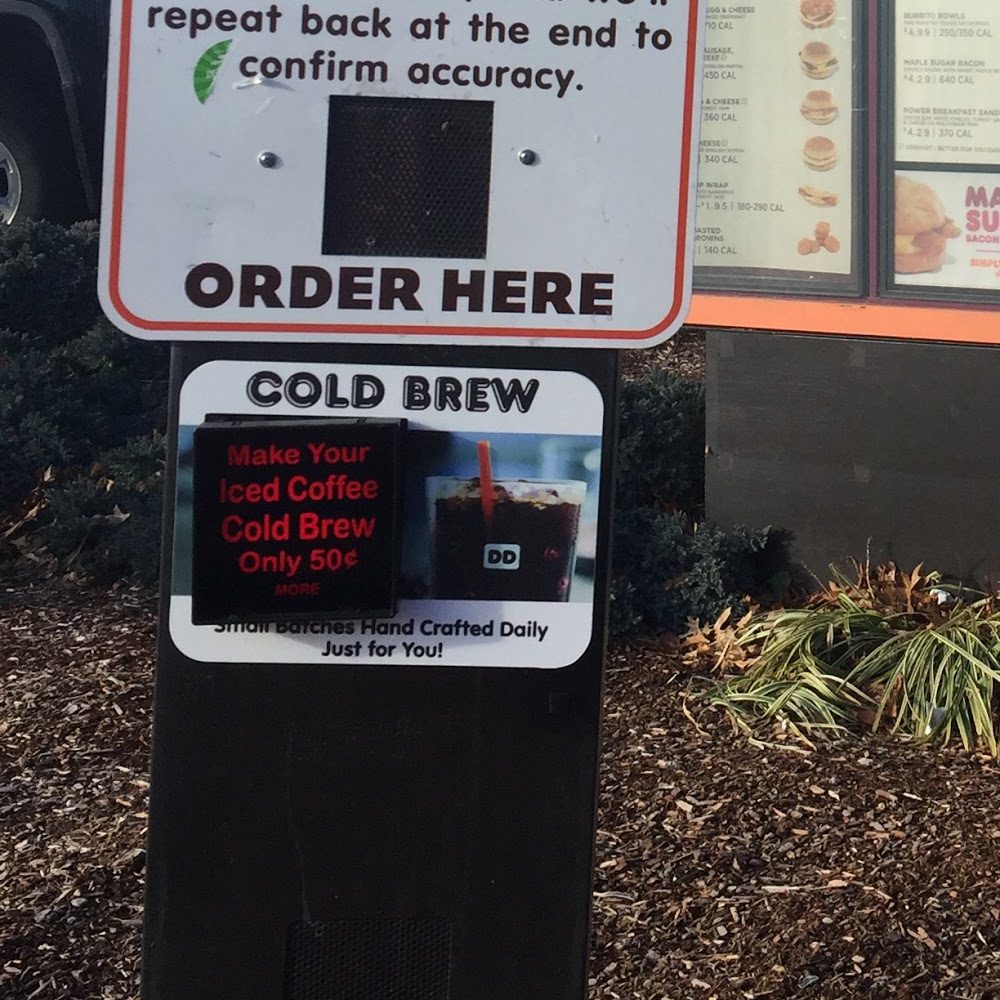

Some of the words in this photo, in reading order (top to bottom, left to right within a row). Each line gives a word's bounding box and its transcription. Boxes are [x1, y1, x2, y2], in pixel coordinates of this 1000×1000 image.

[147, 4, 282, 40] repeat
[300, 5, 391, 40] back
[409, 13, 451, 43] at
[468, 13, 531, 45] the
[547, 16, 618, 48] end
[634, 21, 673, 51] to
[239, 50, 389, 84] confirm
[408, 60, 584, 98] accuracy.
[721, 72, 736, 80] CAL
[958, 76, 974, 84] CAL
[966, 235, 999, 244] BACON
[184, 262, 423, 312] ORDER
[441, 269, 614, 315] HERE
[246, 371, 385, 408] COLD
[402, 375, 540, 413] BREW
[227, 443, 300, 466] Make
[308, 443, 370, 464] Your
[219, 475, 280, 503] Iced
[287, 475, 379, 501] Coffee
[221, 514, 290, 542] Cold
[300, 512, 376, 539] Brew
[239, 551, 301, 577] Only
[309, 549, 358, 571] 50¢
[488, 549, 516, 564] DD
[275, 582, 320, 596] MORE
[276, 620, 355, 635] Batches
[361, 619, 414, 636] Hand
[419, 620, 494, 637] Crafted
[500, 622, 549, 642] Daily
[321, 641, 362, 657] Just
[368, 642, 396, 657] for
[402, 642, 443, 658] You!
